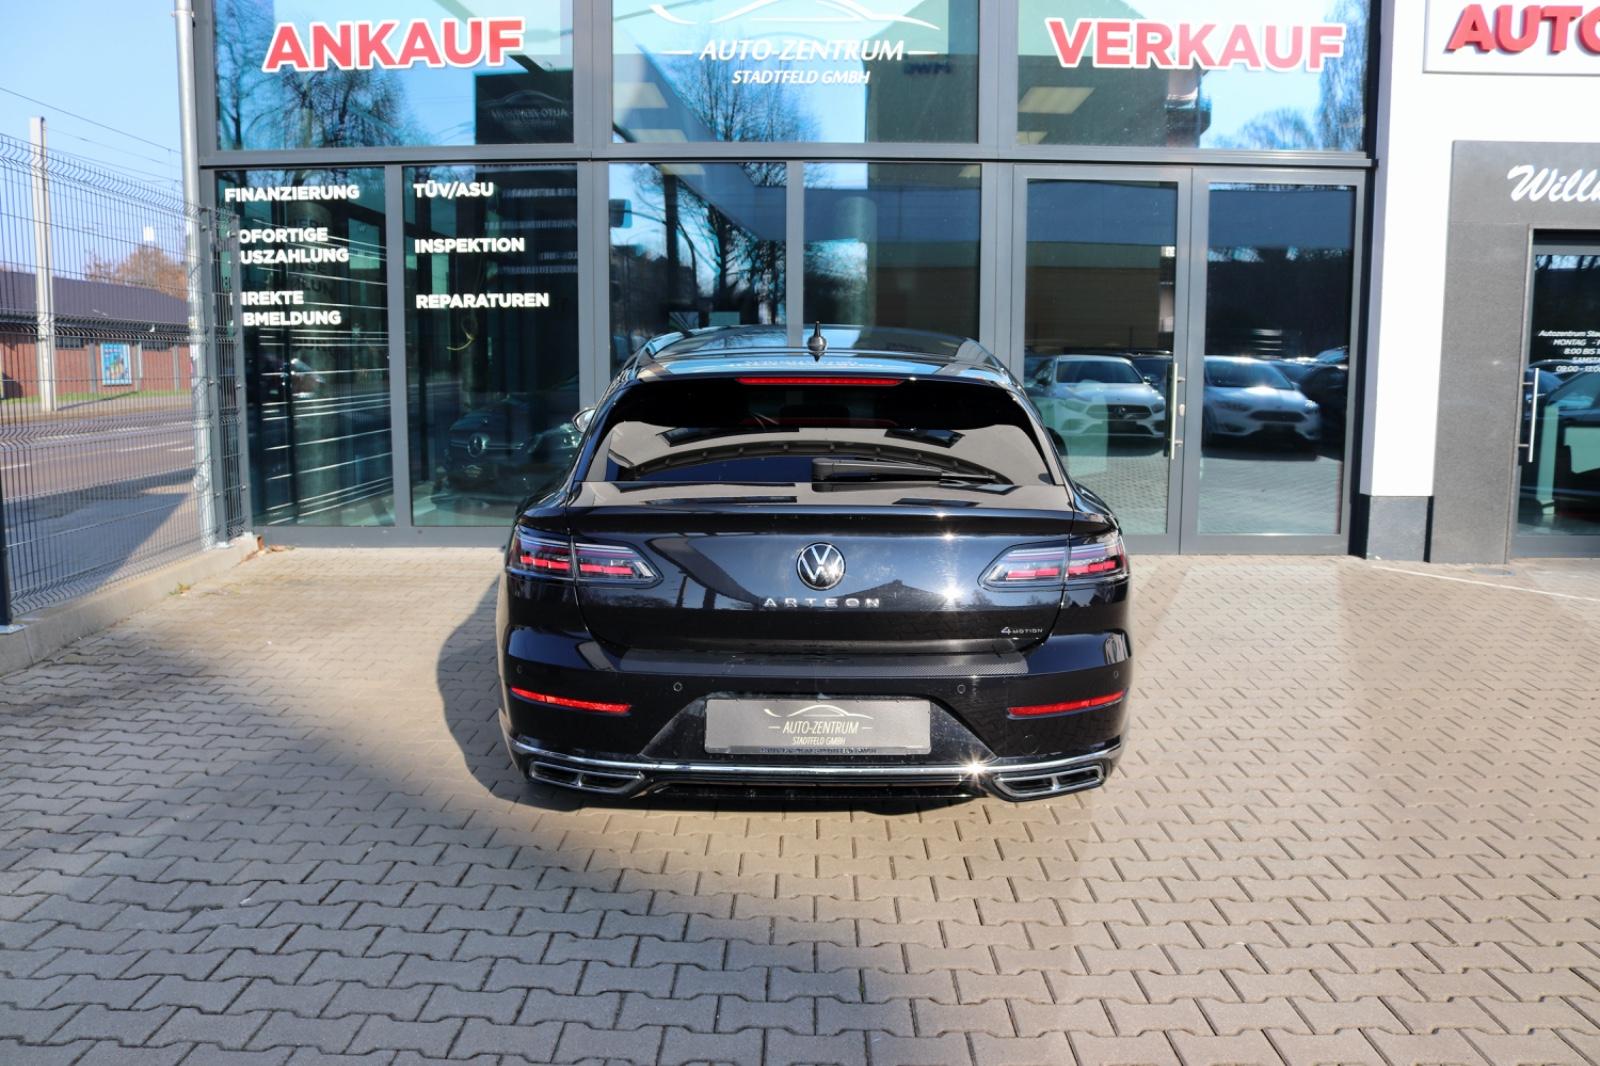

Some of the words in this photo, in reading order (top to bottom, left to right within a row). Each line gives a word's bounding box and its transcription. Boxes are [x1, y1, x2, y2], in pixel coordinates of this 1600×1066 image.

[262, 16, 525, 72] ANKAUF
[699, 39, 904, 61] AUTO-ZENTRUM
[1045, 17, 1346, 72] VERKAUF
[732, 70, 819, 84] STADTFELD
[822, 71, 870, 84] GMBH
[225, 185, 360, 202] FINANZIERUNG
[413, 180, 494, 199] TÜV/ASU
[228, 227, 329, 244] OFORTIGE
[414, 237, 525, 253] INSPEKTION
[230, 248, 349, 264] USZAHLUNG
[230, 290, 304, 305] IREKTE
[415, 292, 550, 309] REPARATUREN
[232, 310, 341, 326] BMELDUNG
[1553, 338, 1587, 346] MONTAG
[763, 597, 880, 608] ARTEON
[783, 720, 859, 734] AUTO-ZENTRUM
[792, 736, 825, 745] STADTFELD
